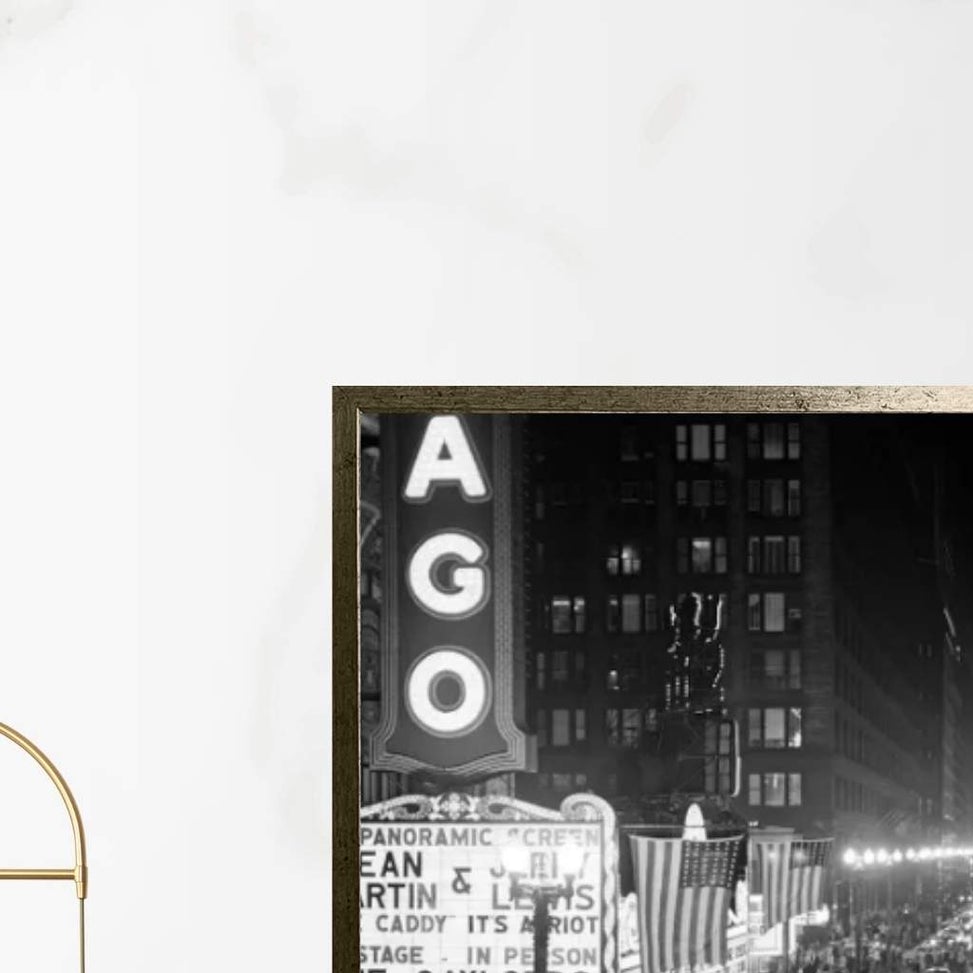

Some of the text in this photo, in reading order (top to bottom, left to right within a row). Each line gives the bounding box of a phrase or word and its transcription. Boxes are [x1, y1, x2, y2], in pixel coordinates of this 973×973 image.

[404, 414, 487, 734] AGO
[360, 828, 493, 847] PANORAMIC
[452, 867, 472, 894] &
[360, 883, 595, 911] RTIN LEIS
[548, 916, 599, 935] RIOT
[468, 947, 491, 965] IN
[504, 947, 597, 966] PESON
